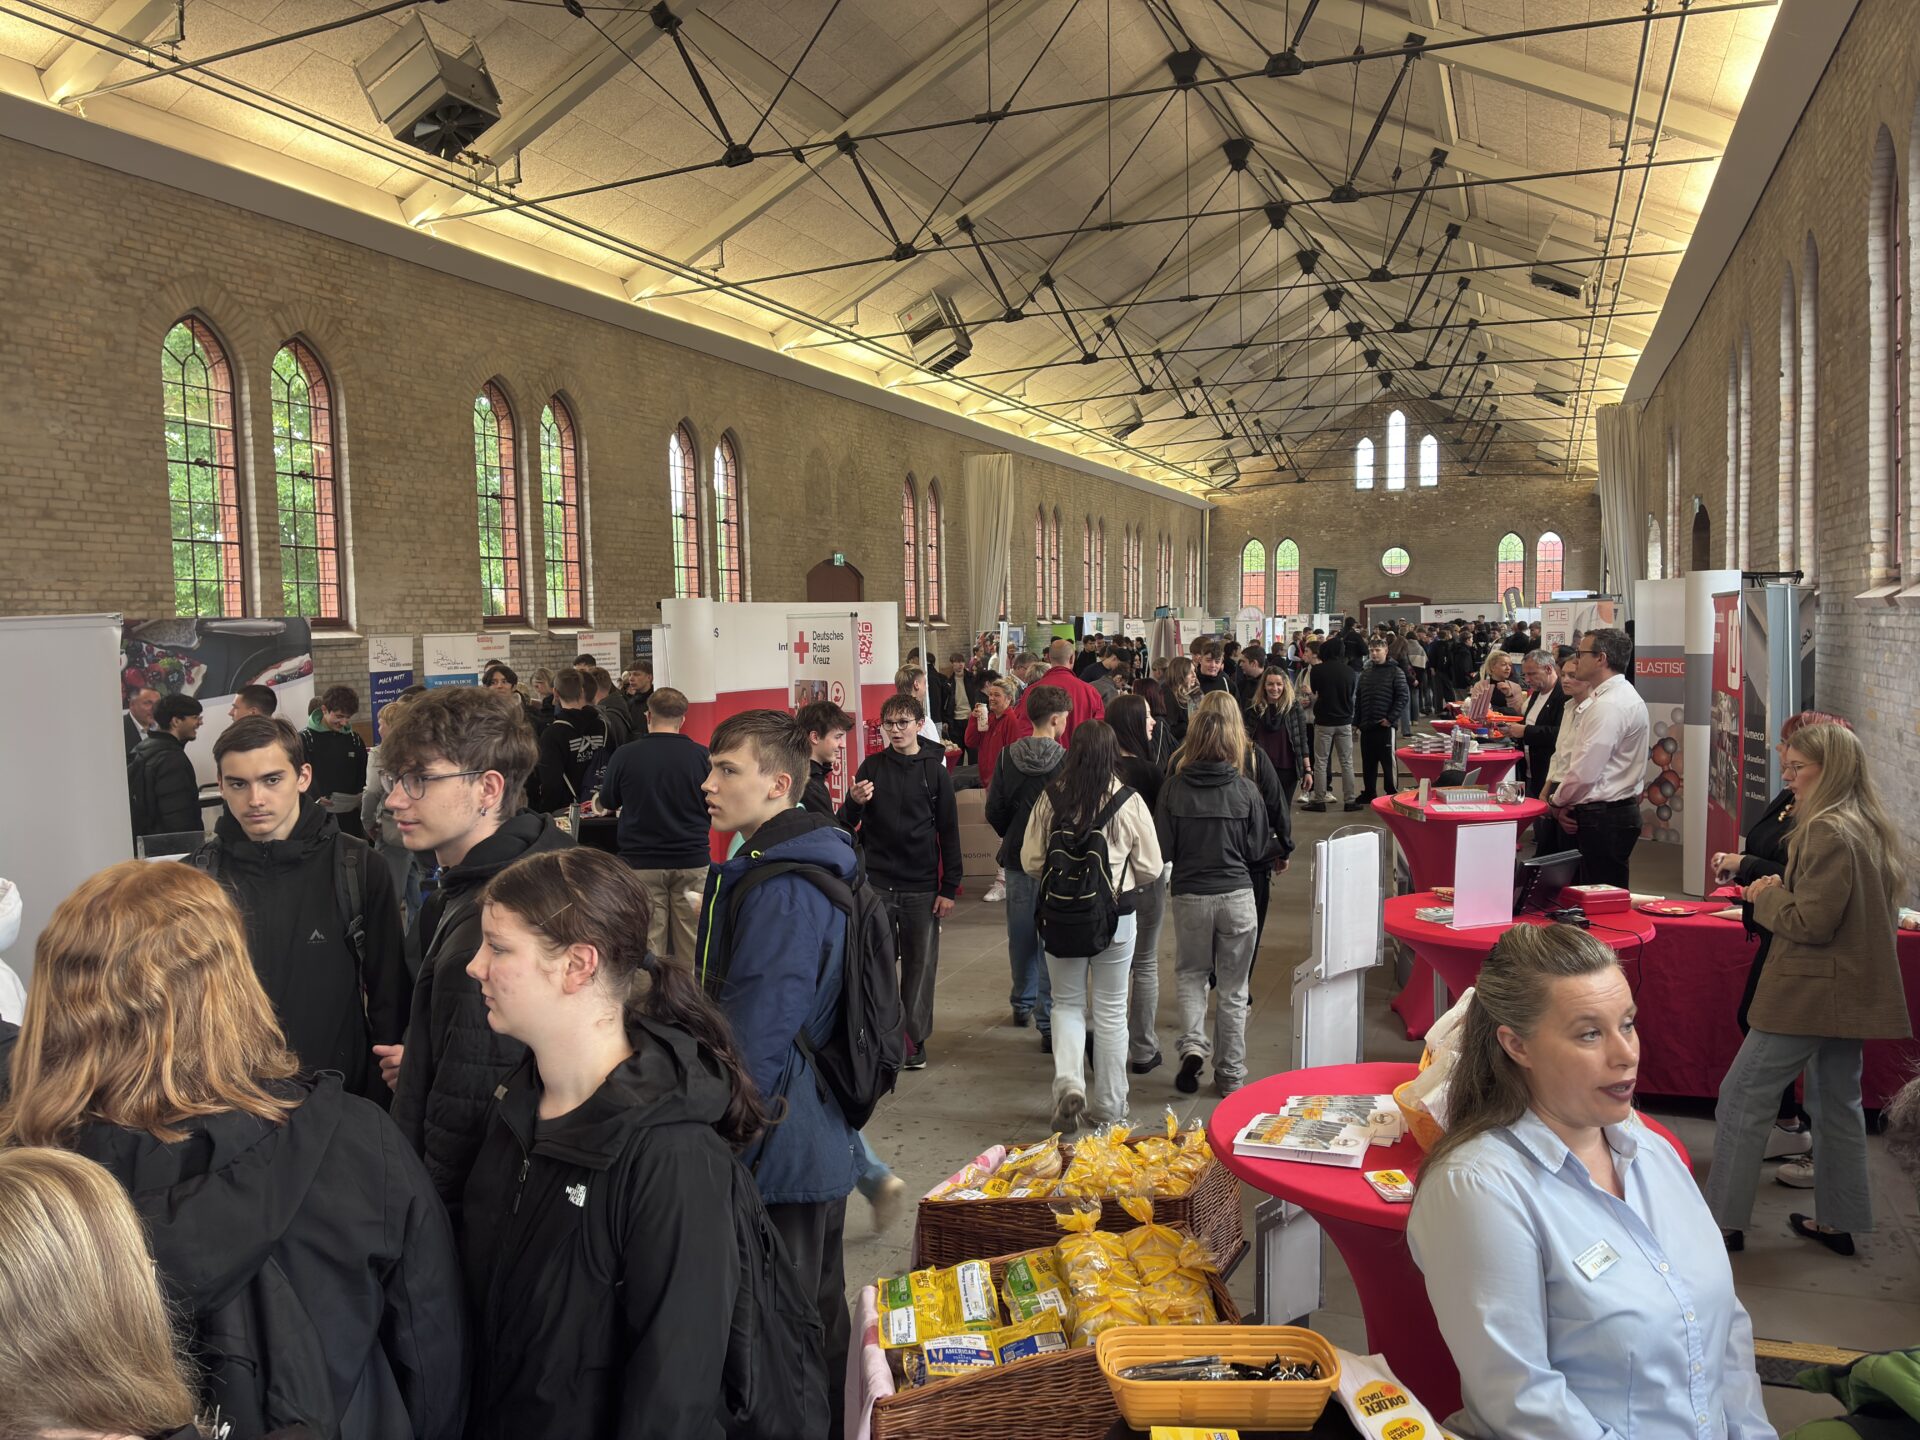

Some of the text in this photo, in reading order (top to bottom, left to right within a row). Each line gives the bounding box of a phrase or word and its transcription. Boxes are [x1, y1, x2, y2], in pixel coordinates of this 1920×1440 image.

[1548, 609, 1567, 620] PTE
[812, 630, 844, 641] Deutsches
[812, 643, 830, 653] Rotes
[812, 655, 831, 665] Kreuz
[1364, 1395, 1406, 1416] GOLDEN
